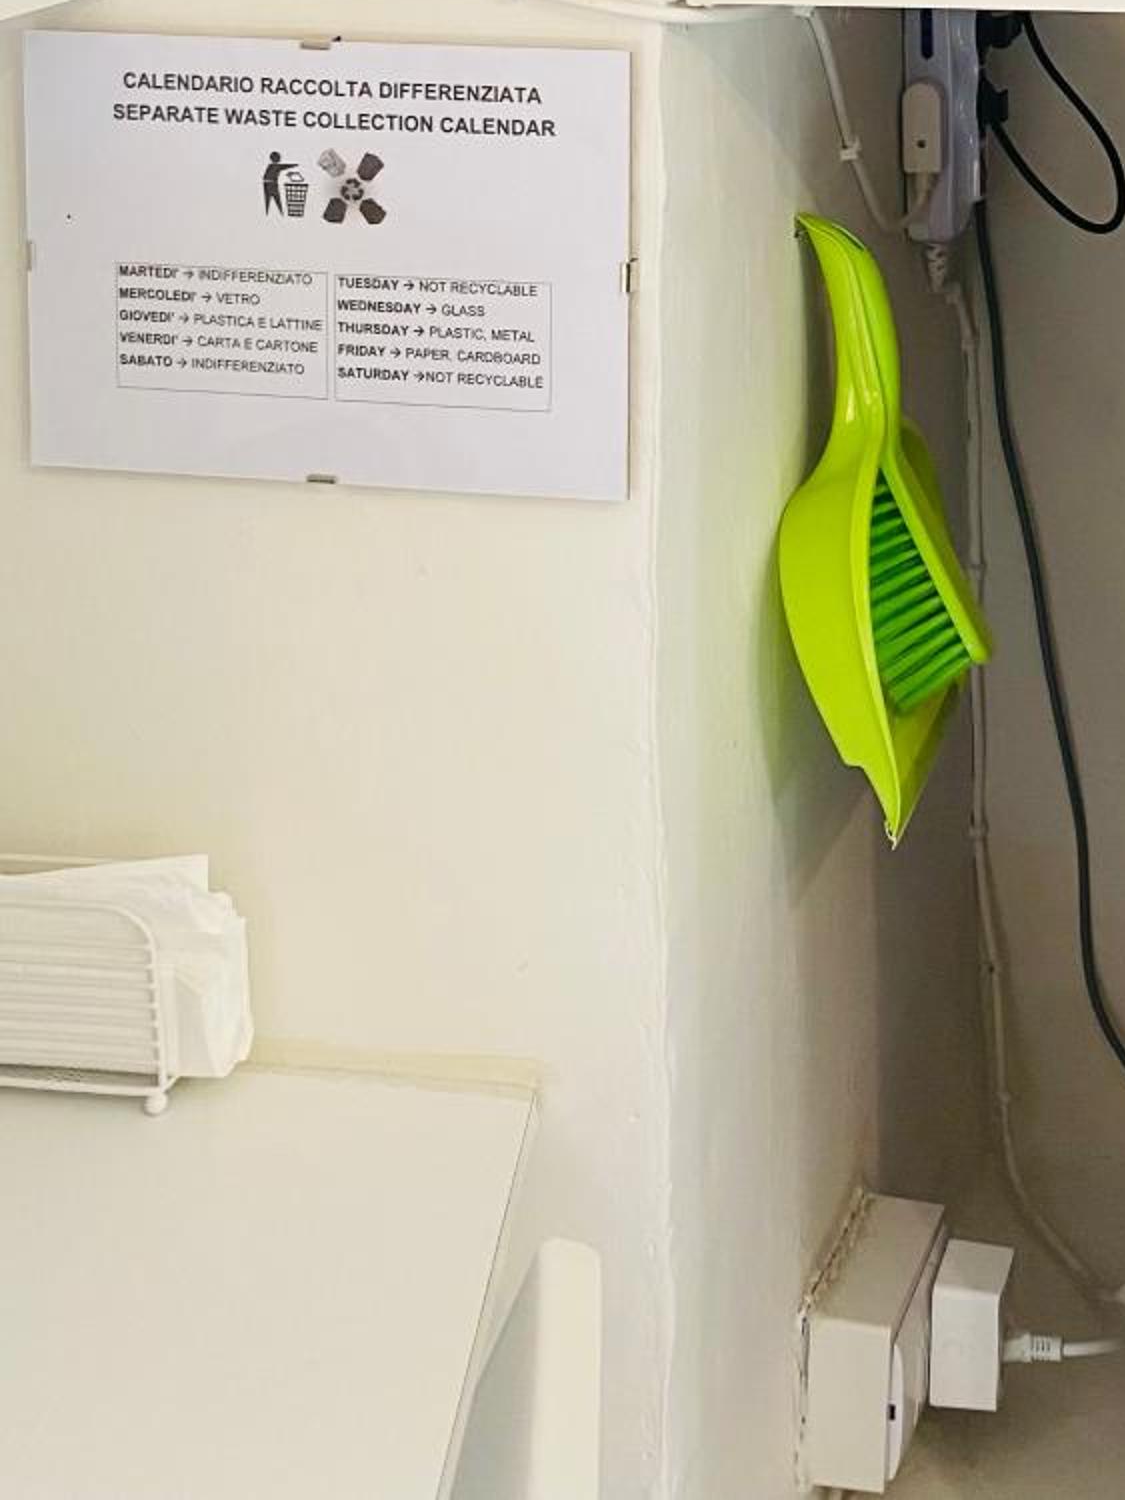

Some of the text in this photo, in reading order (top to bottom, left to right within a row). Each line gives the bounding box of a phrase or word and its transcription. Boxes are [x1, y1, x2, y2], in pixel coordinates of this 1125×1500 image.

[123, 72, 542, 104] CALENDARIO RACCOLTA DIFFERENZIATA
[113, 104, 556, 137] SEPARATE WASTE COLLECTION CALENDAR
[199, 269, 313, 285] INDIFFERENZIATO
[338, 277, 538, 297] TUESDAY NOT RECYCLABLE
[216, 291, 261, 305] VETRO
[337, 300, 486, 317] WEDNESDAY GLASS
[119, 309, 324, 331] GIOVEDI' PLASTICA E LATTINE
[119, 331, 319, 353] VENERDI' CARTA E CARTONE
[338, 321, 409, 336] THURSDAY
[491, 329, 536, 343] METAL
[119, 354, 305, 375] SABATO INDIFFERENZIATO
[338, 343, 386, 357] FRIDAY
[457, 349, 541, 365] CARDBOARD
[337, 366, 544, 389] SATURDAY NOT RECYCLABLE
